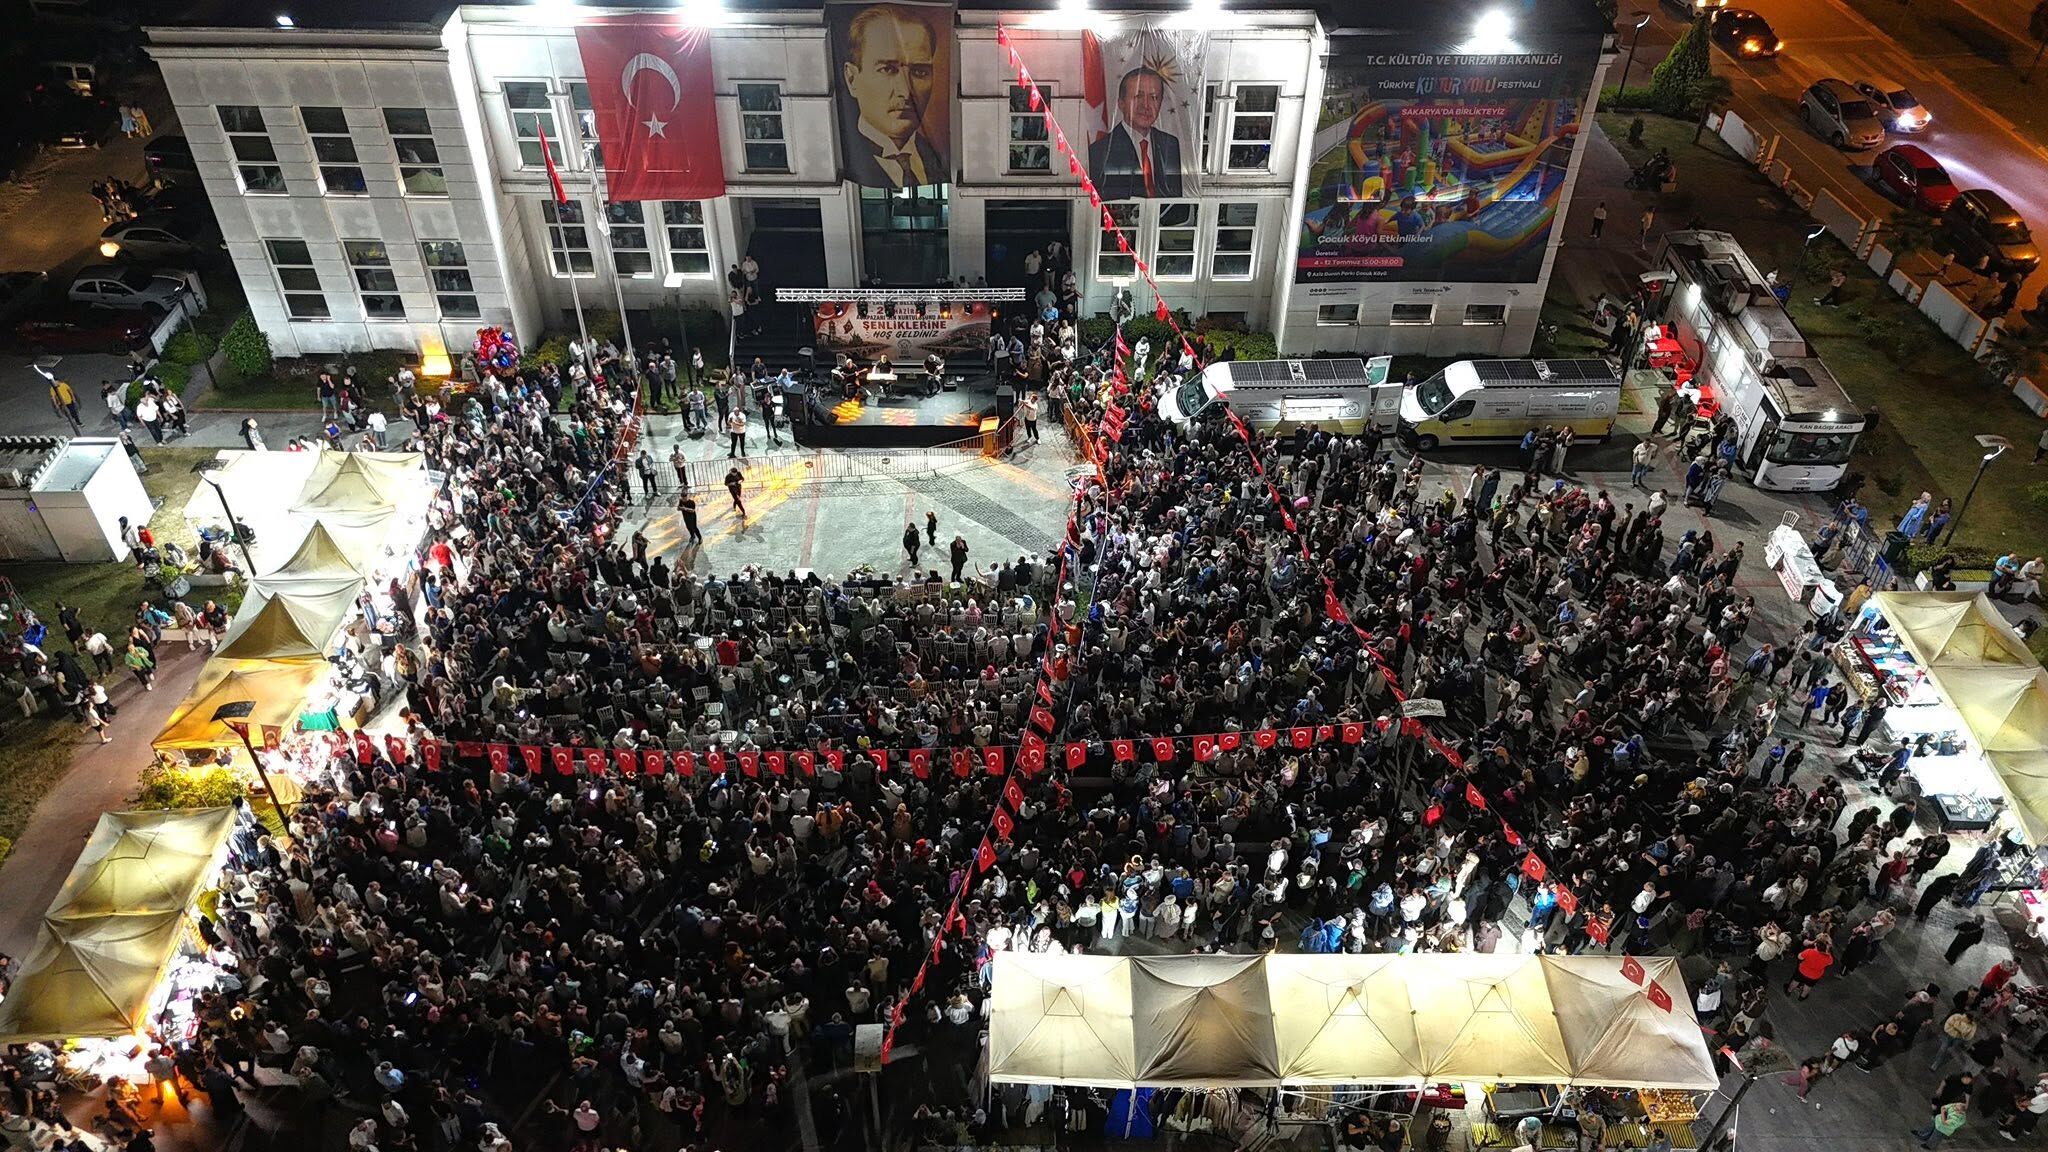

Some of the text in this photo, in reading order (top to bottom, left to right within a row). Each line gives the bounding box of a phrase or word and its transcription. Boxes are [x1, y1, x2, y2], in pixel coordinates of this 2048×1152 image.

[1366, 55, 1386, 65] T.C.
[1388, 53, 1433, 65] KÜLTÜR
[1436, 55, 1451, 65] VE
[1498, 52, 1563, 65] BAKANLIĞI
[1378, 79, 1415, 89] TÜRKİYE
[1497, 79, 1542, 89] FESTİVALİ
[1401, 106, 1507, 116] SAKARYA'DA BİRLİKTEYİZ
[1317, 234, 1433, 245] Çocuk Köyü Etkinlikleri
[862, 320, 947, 331] ŞENLİKLERİNE
[873, 329, 940, 340] HOŞ GELDİNİZ
